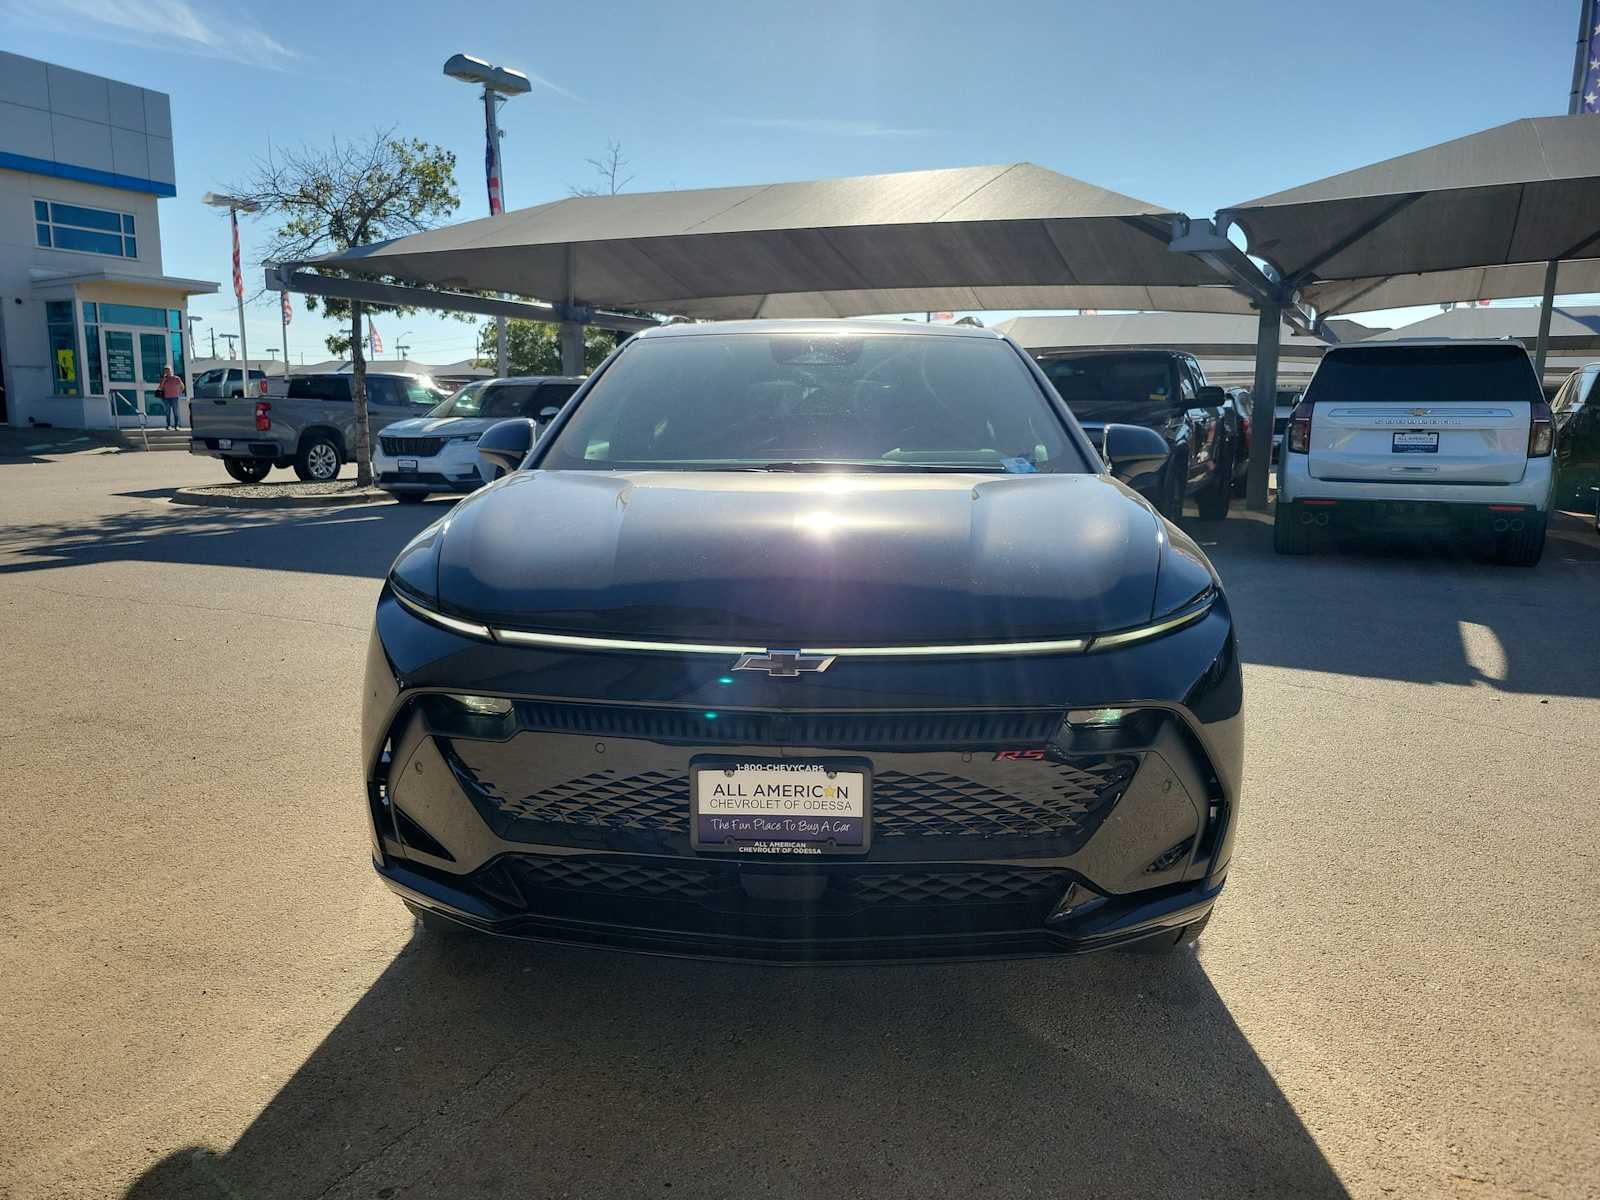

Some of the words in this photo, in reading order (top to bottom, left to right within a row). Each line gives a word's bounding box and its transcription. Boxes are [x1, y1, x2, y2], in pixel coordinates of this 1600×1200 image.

[992, 749, 1045, 762] RS
[736, 764, 824, 772] 1-800-CHEVYCARS
[713, 783, 747, 797] ALL
[709, 799, 781, 809] CHEVROLET
[784, 800, 800, 810] OF
[803, 801, 852, 811] ODESSA
[711, 818, 729, 830] The
[732, 819, 750, 830] Fun
[753, 818, 781, 830] Place
[783, 819, 796, 831] To
[798, 820, 819, 835] Buy
[821, 820, 830, 832] A
[832, 820, 850, 832] Car
